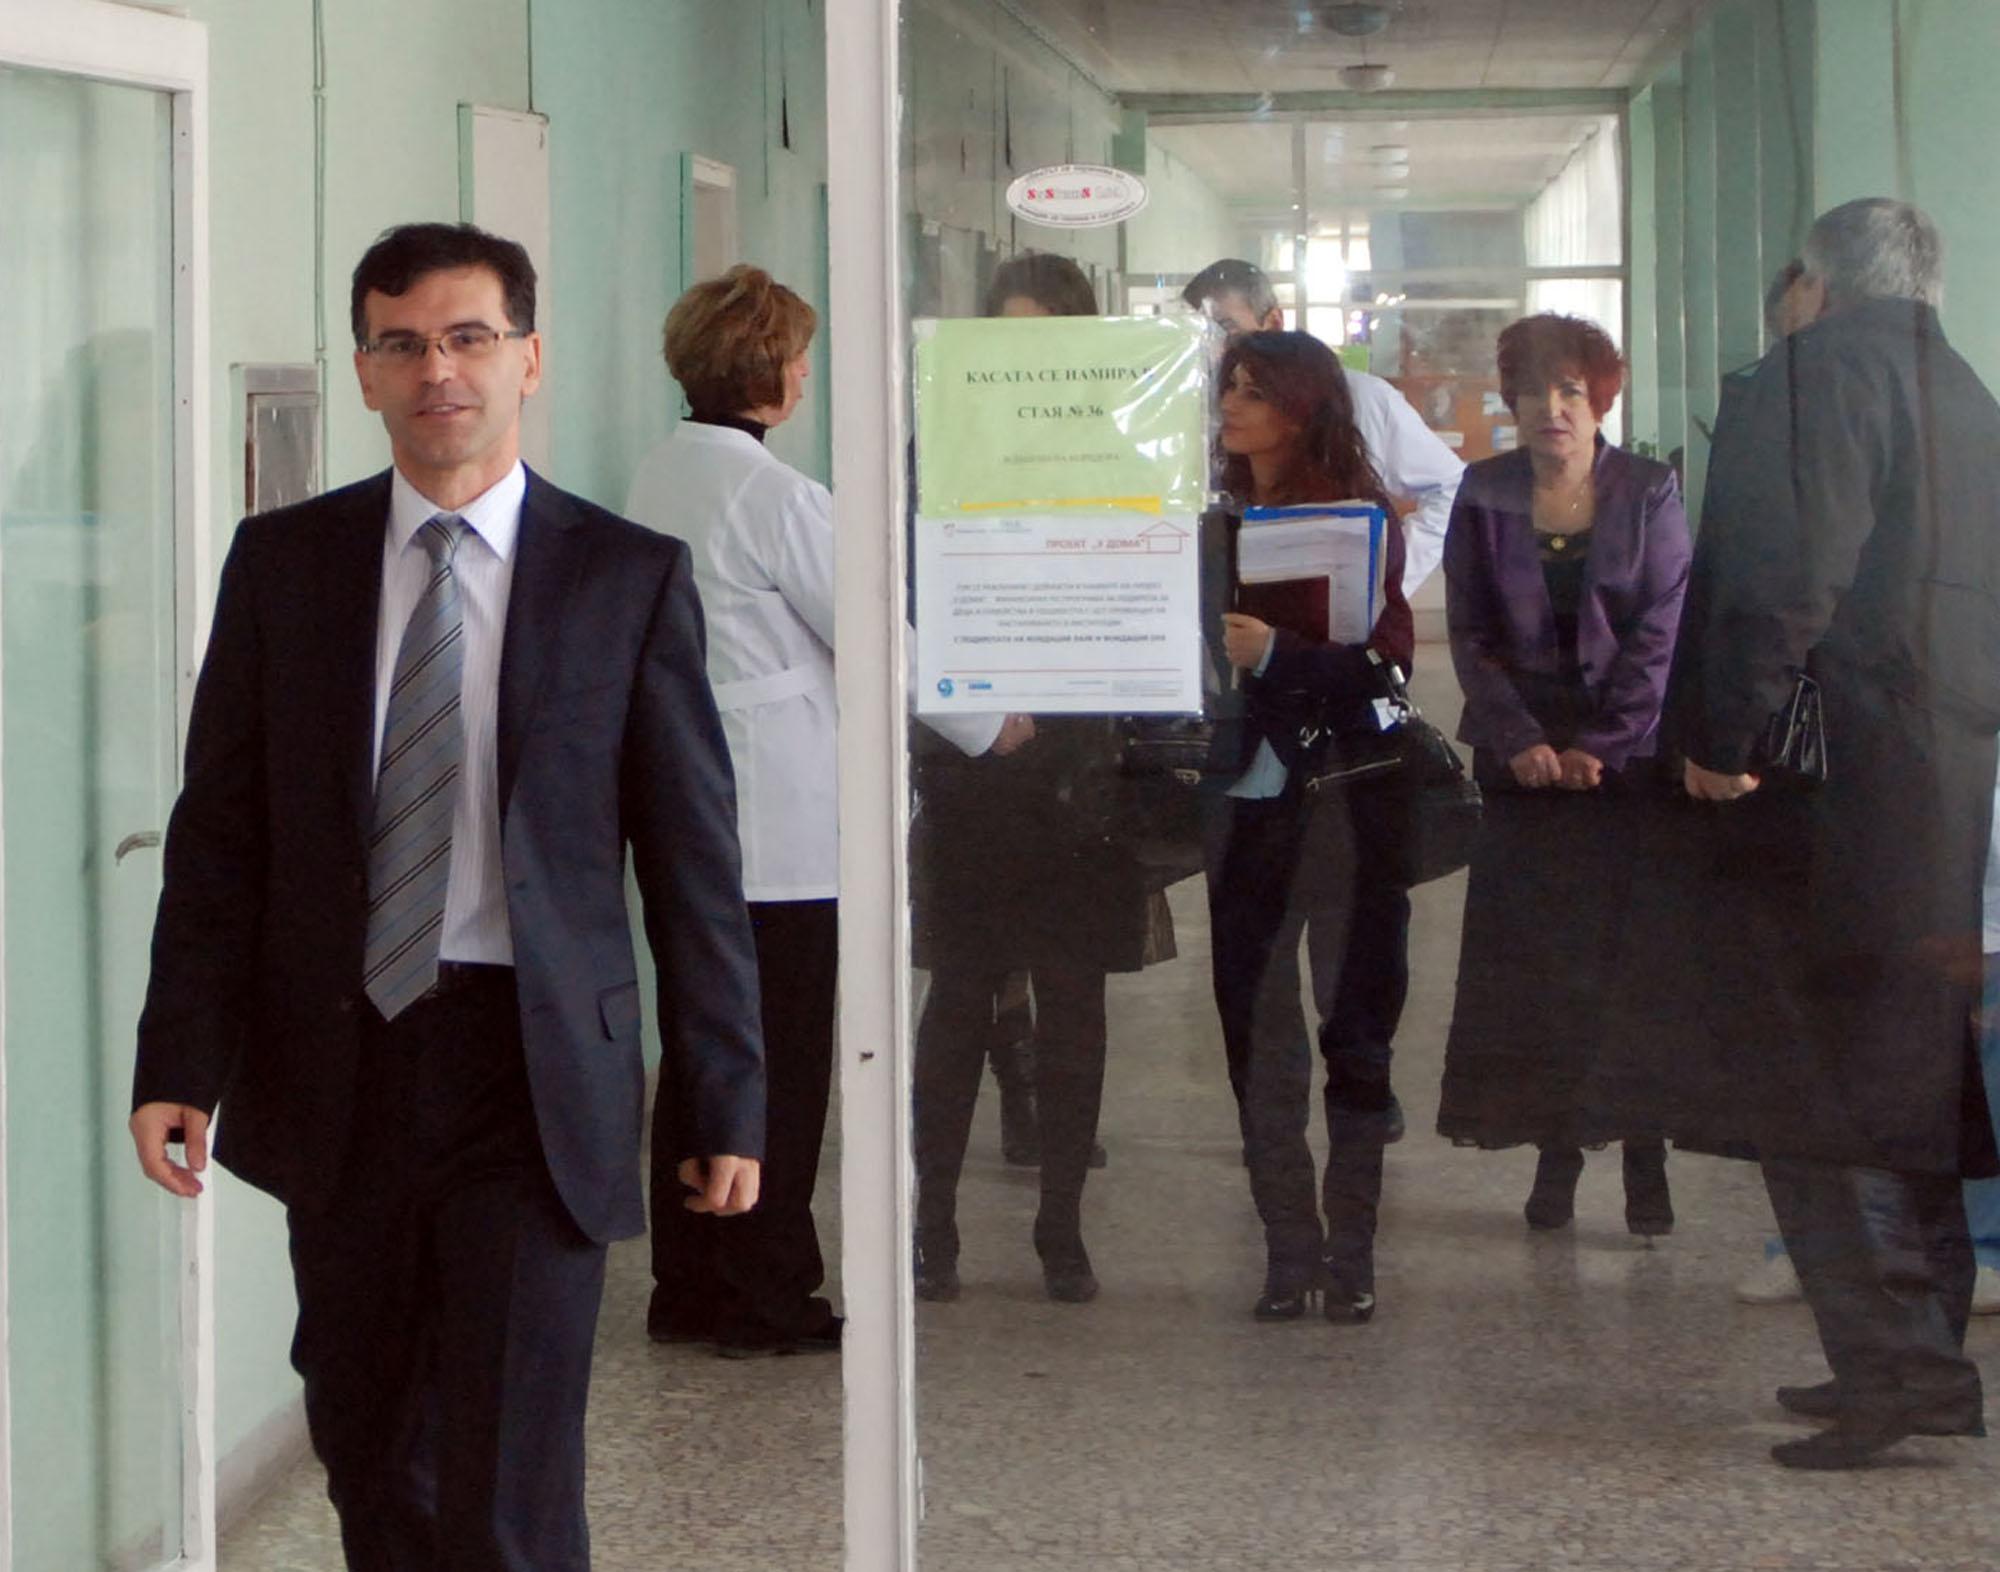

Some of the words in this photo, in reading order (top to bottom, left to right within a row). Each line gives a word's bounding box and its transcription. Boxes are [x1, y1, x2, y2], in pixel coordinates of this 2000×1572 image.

[966, 370, 1034, 383] КАСАТА
[1038, 369, 1057, 381] СЕ
[1065, 367, 1138, 381] НАМИРА
[1017, 405, 1063, 419] СТАЯ
[1067, 404, 1084, 417] №
[1087, 404, 1104, 417] 36
[1046, 539, 1086, 549] ПРОЕКТ
